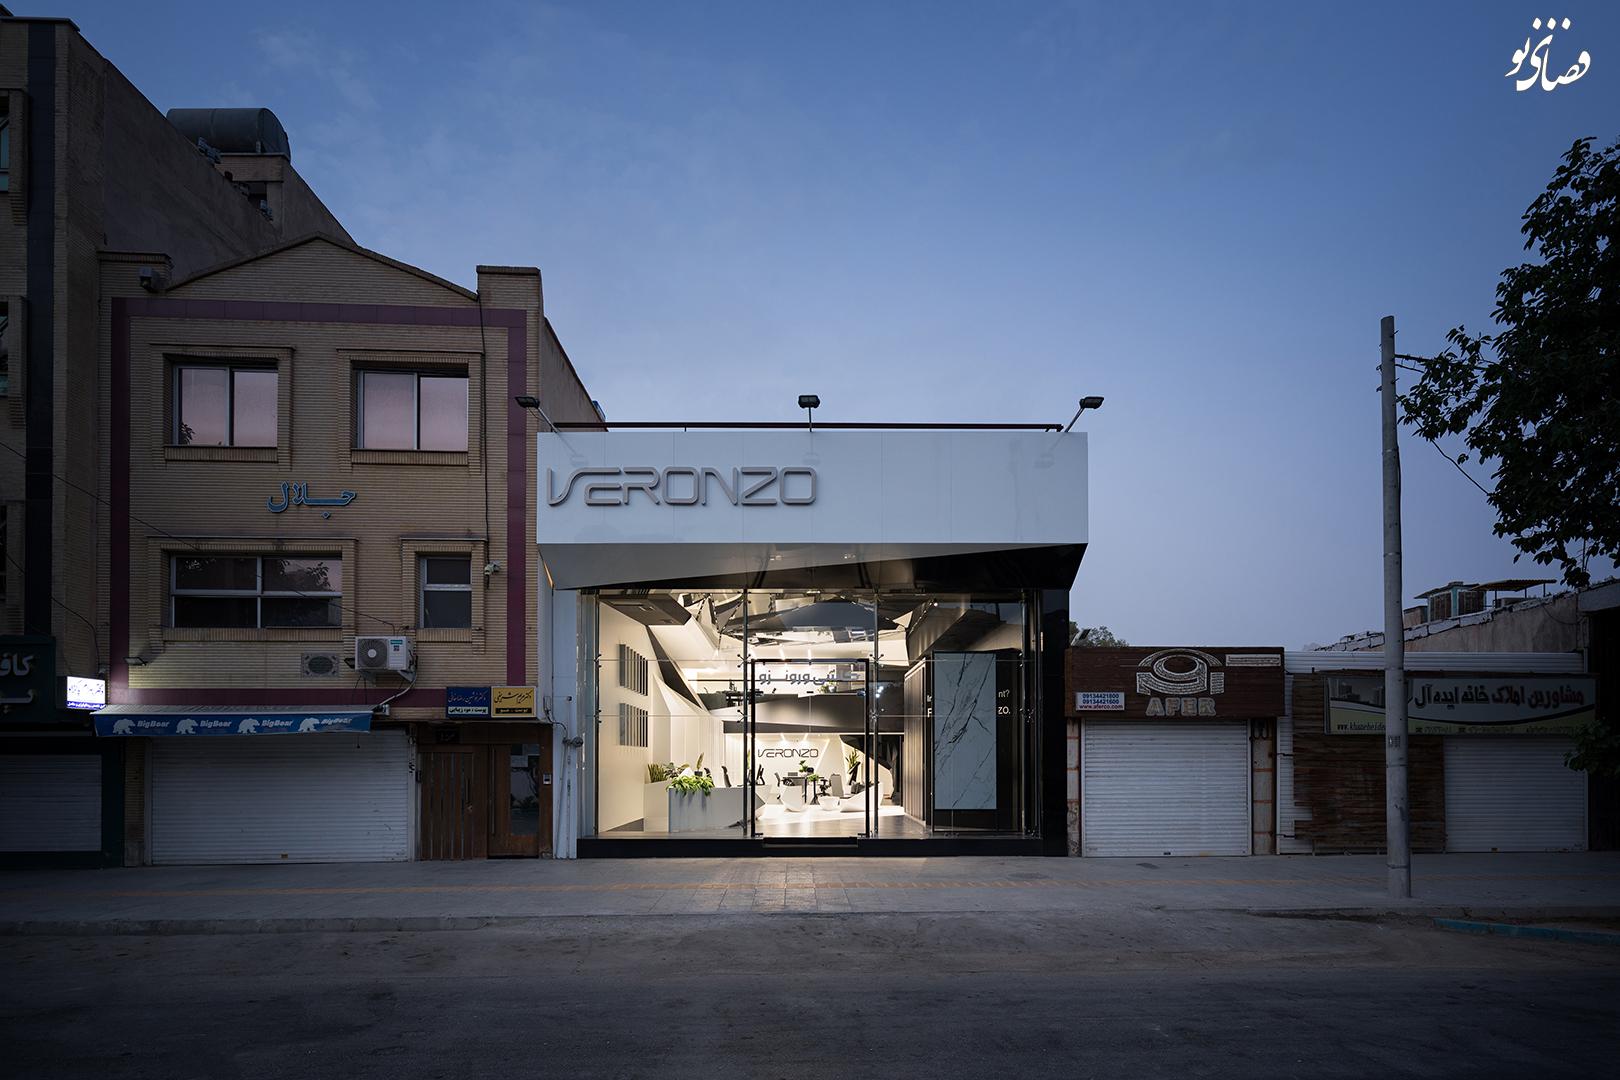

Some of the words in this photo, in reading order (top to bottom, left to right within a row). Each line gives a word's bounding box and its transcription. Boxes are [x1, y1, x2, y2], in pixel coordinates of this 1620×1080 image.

[547, 466, 817, 506] VERONZO
[267, 481, 357, 519] جلال
[0, 651, 34, 677] کاف
[759, 669, 811, 685] ورونزو
[521, 690, 533, 703] دکتر
[1414, 684, 1431, 709] آل
[1434, 686, 1458, 709] ایده
[1461, 685, 1489, 704] خانه
[1492, 685, 1525, 705] املاک
[1528, 684, 1585, 709] مشاورین
[1145, 697, 1217, 717] AFER
[757, 748, 819, 759] VERONZO
